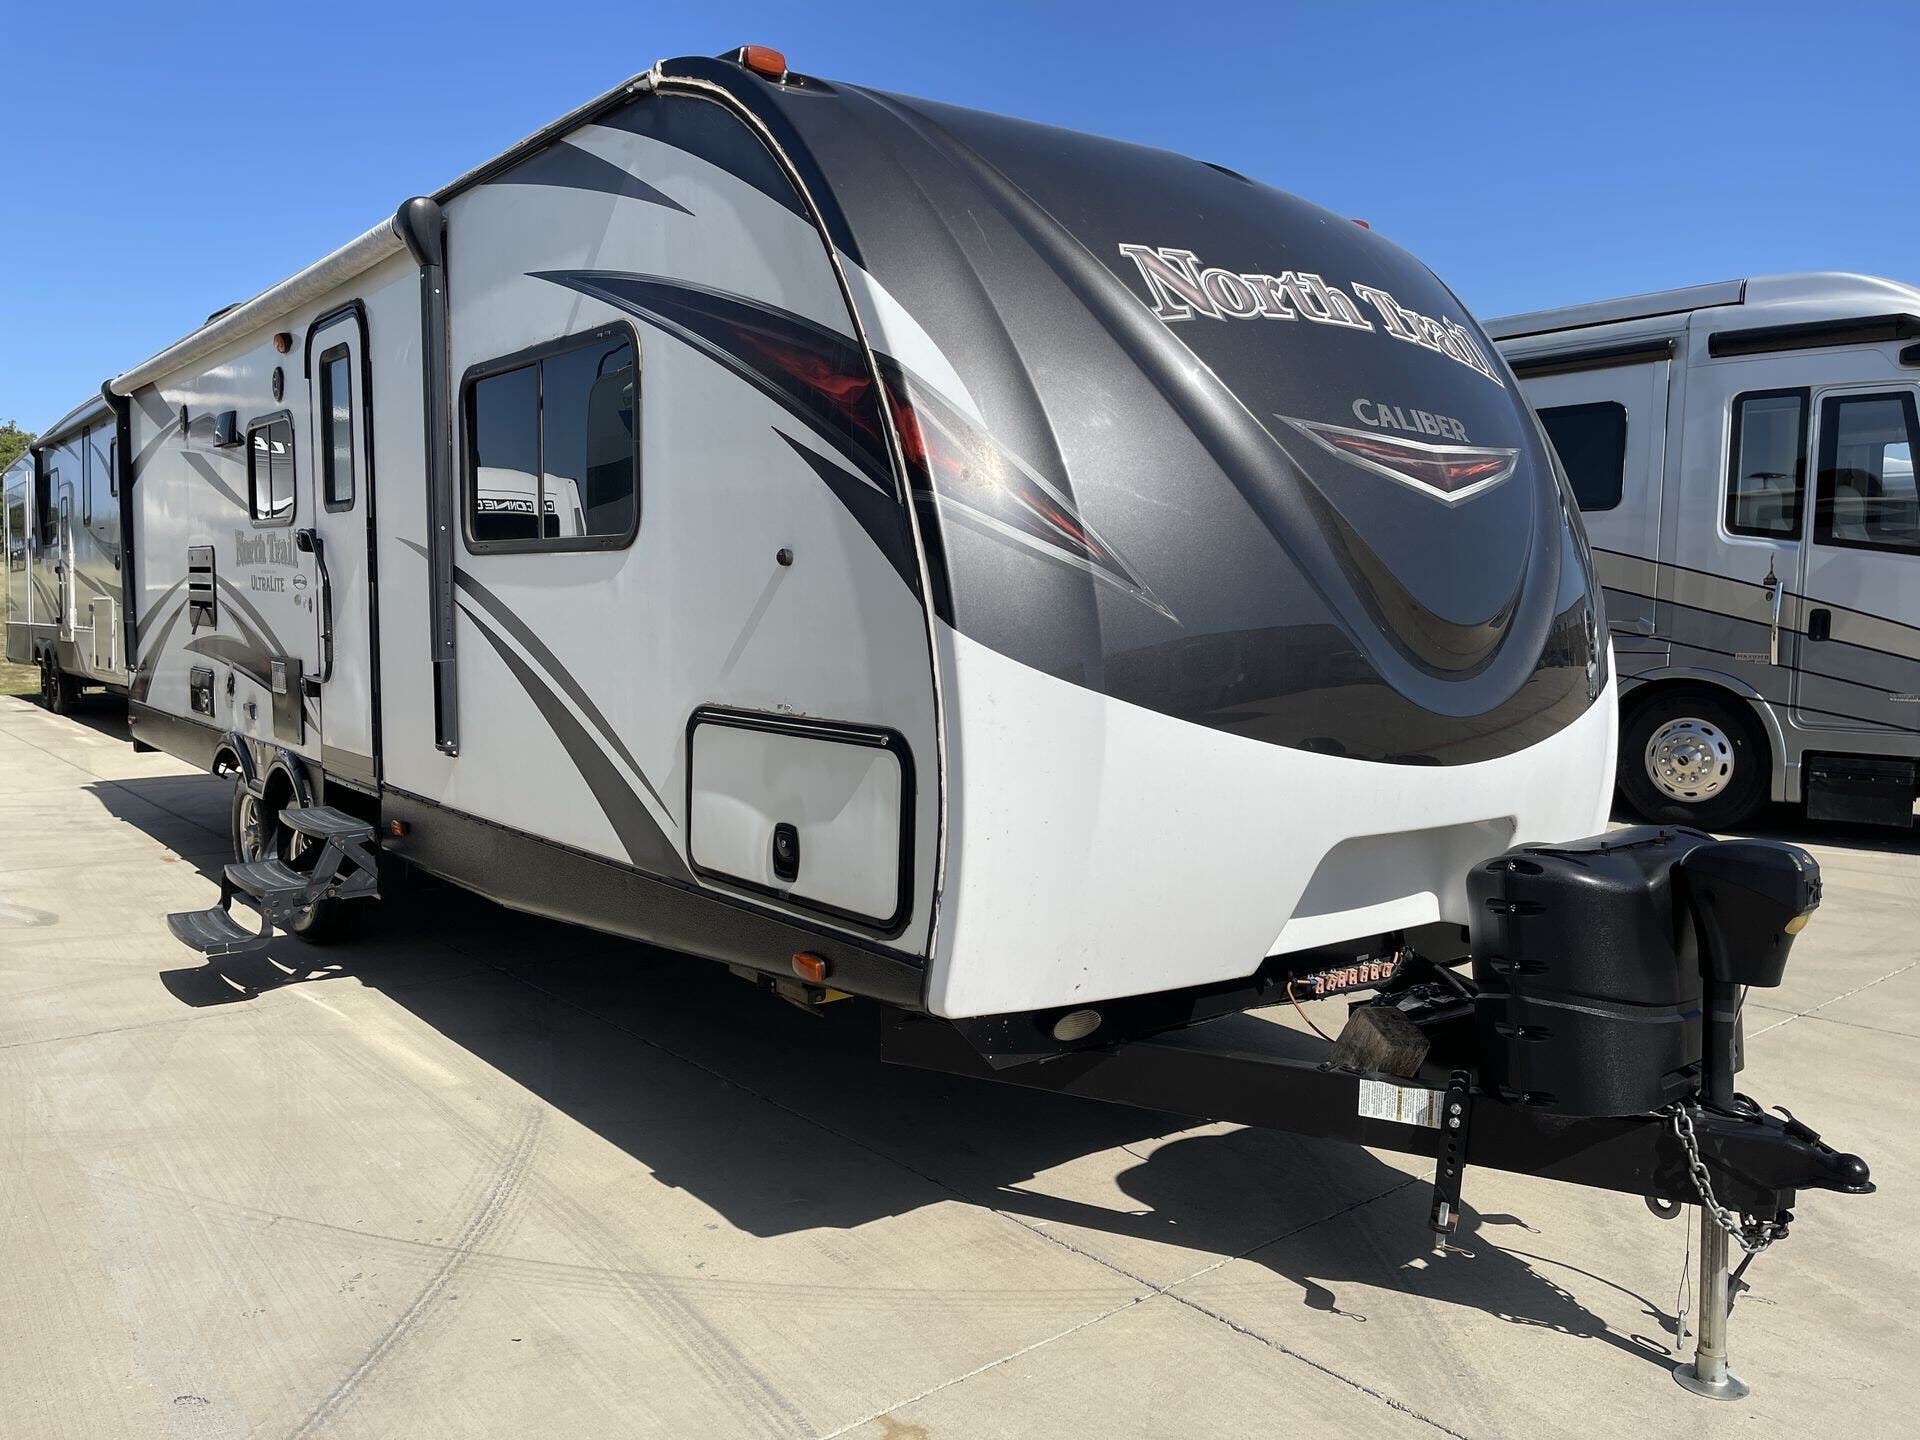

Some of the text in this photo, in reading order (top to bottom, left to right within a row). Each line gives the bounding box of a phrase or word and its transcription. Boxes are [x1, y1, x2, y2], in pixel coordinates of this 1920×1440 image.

[1118, 243, 1505, 388] North Trail
[1352, 399, 1472, 444] CALIBER
[235, 529, 298, 568] North Trail
